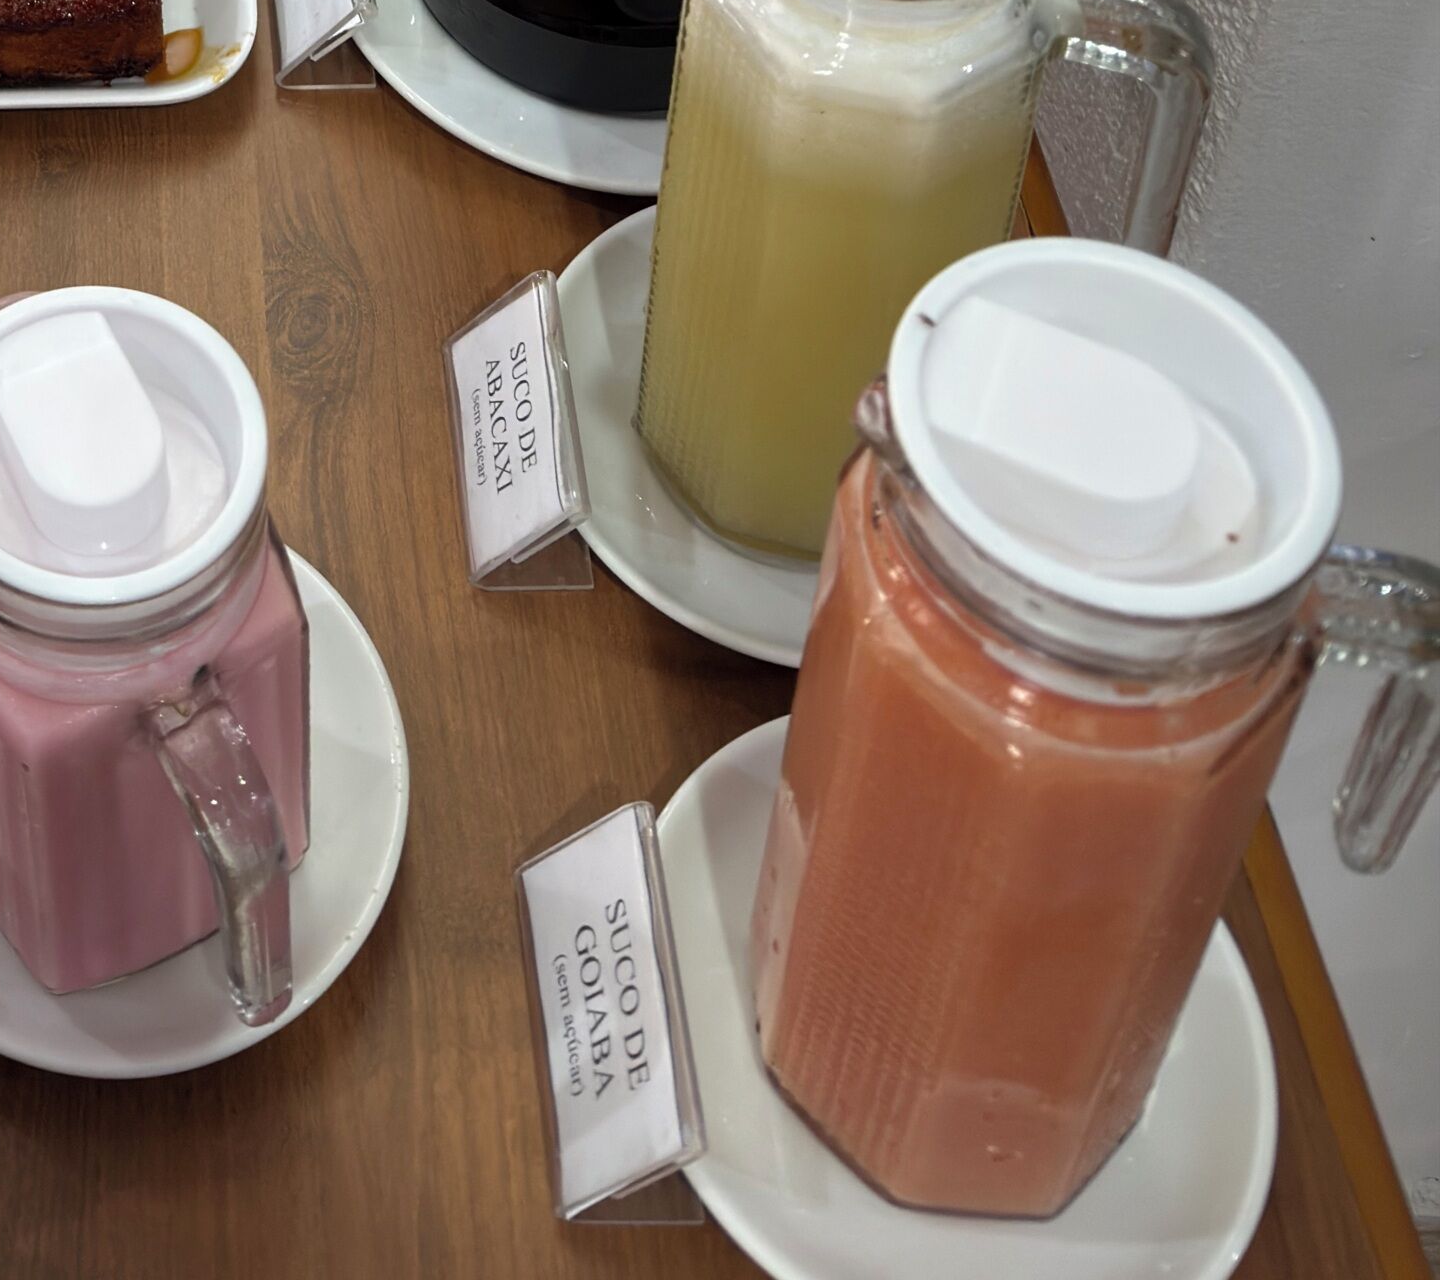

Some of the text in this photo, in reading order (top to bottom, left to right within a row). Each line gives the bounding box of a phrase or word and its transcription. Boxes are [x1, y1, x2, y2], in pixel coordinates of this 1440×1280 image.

[471, 388, 487, 486] (sem açúcar)
[485, 360, 513, 494] ABACAXI
[510, 341, 538, 473] SUCO DE
[552, 953, 585, 1097] (sem açúcar)
[574, 924, 615, 1101] GOIABA
[604, 898, 650, 1091] SUCO DE
